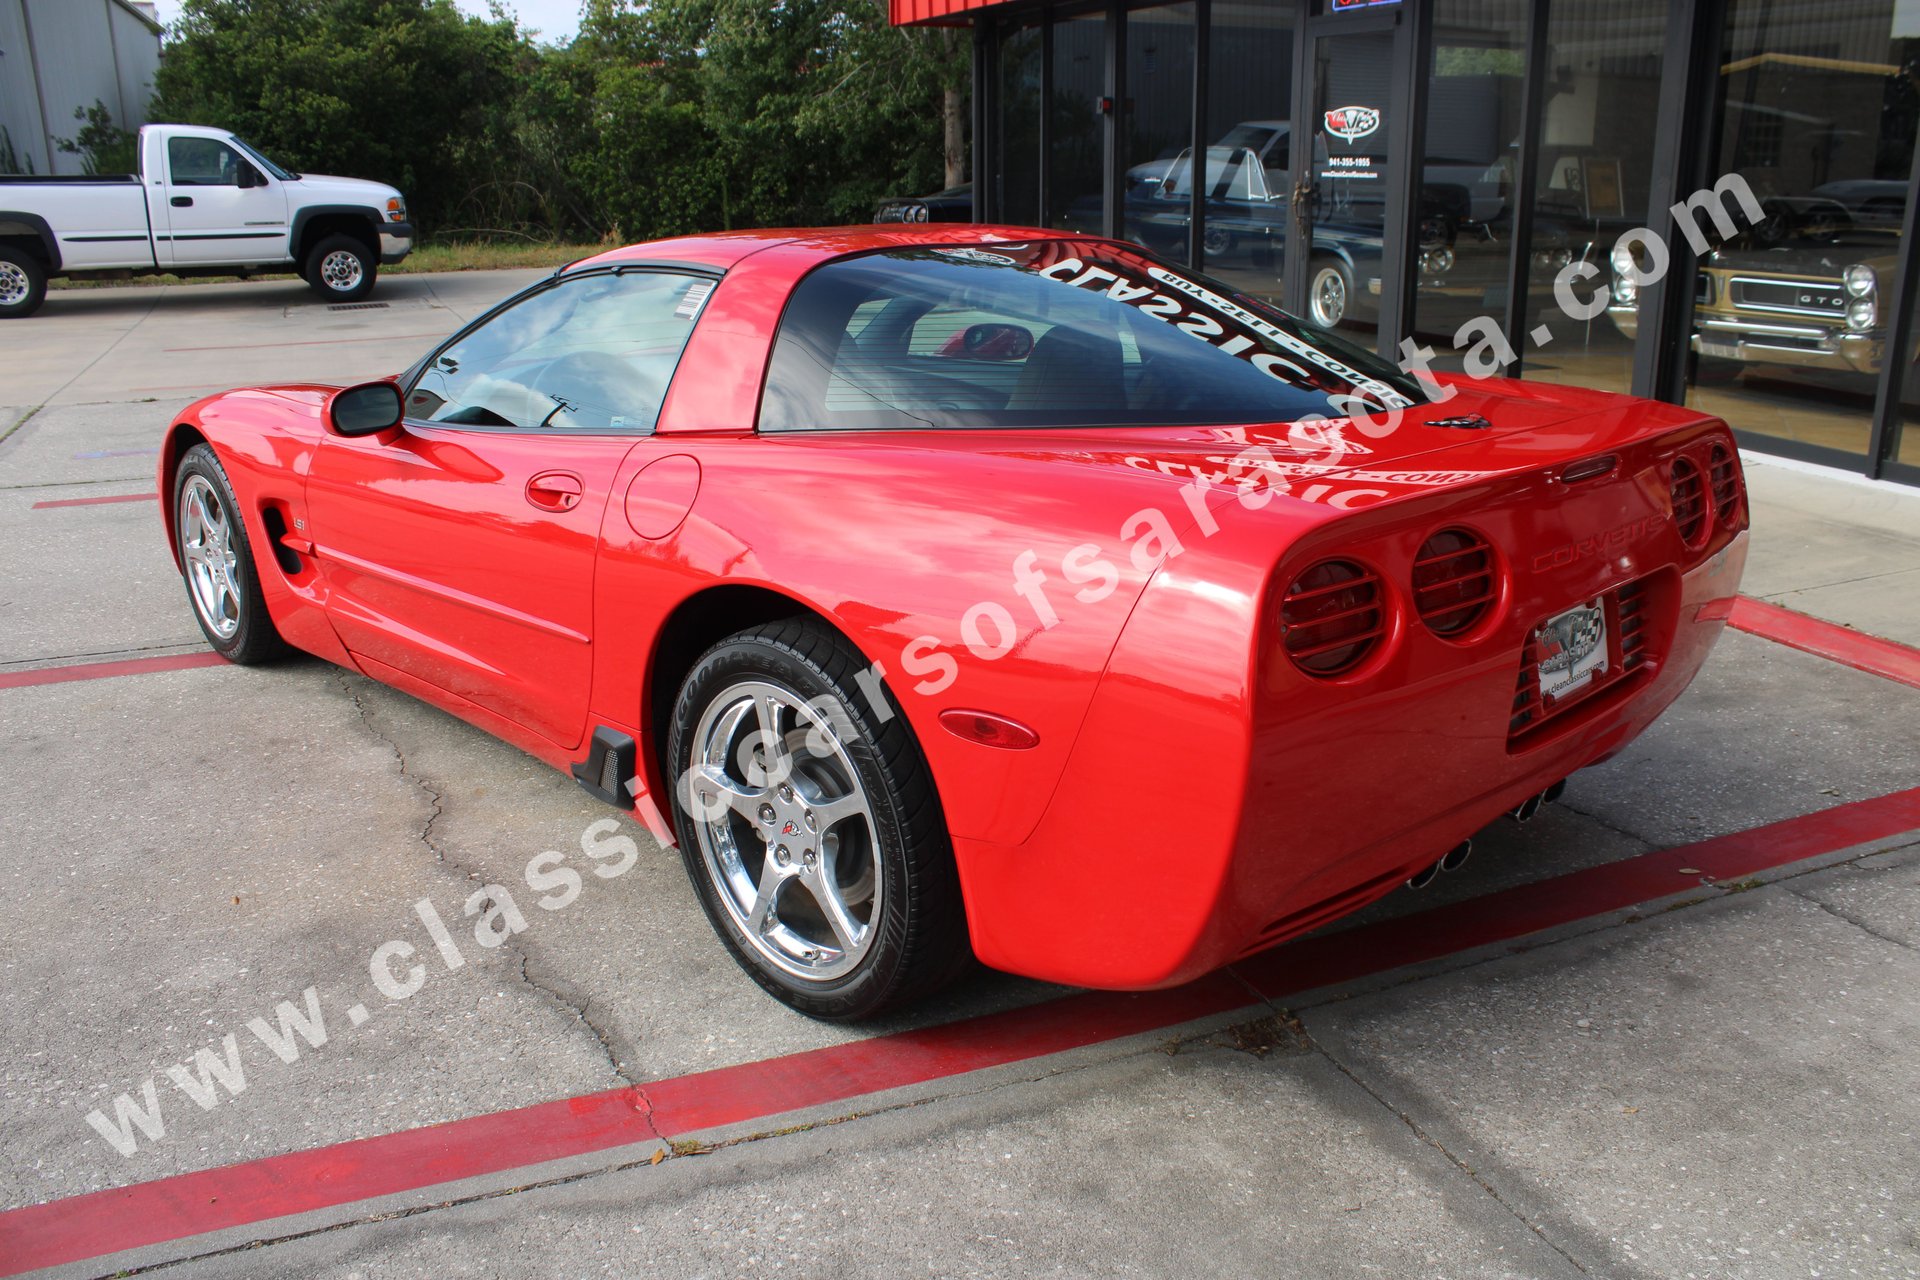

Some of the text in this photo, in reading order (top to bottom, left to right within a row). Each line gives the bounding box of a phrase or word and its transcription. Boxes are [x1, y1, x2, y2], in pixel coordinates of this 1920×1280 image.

[1329, 157, 1370, 167] 941-355-1955
[1800, 295, 1843, 306] GTO
[1531, 512, 1667, 574] CORVETTE
